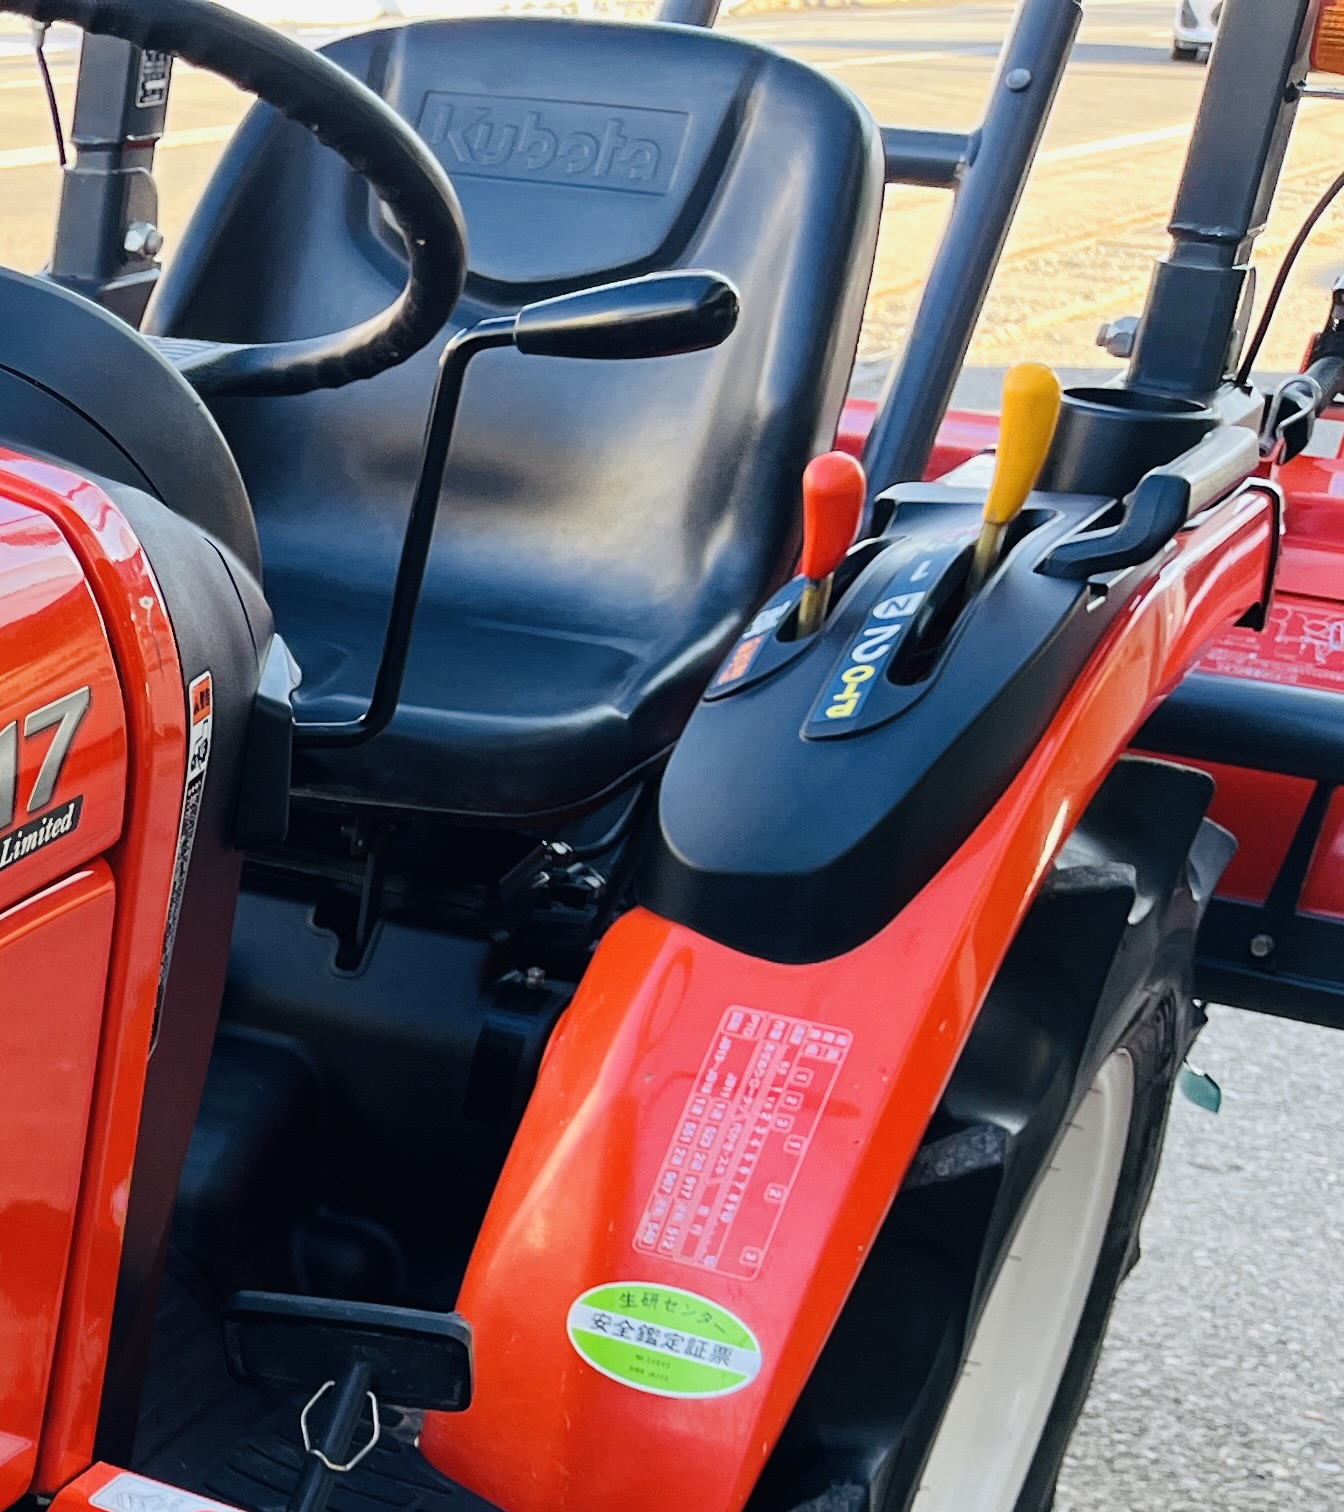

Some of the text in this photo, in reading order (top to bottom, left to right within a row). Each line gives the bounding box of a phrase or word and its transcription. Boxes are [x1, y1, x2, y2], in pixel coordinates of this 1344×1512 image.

[429, 104, 662, 183] Kubota
[589, 1311, 735, 1367] 安全鑑定証票
[618, 1289, 727, 1334] 生研センター
